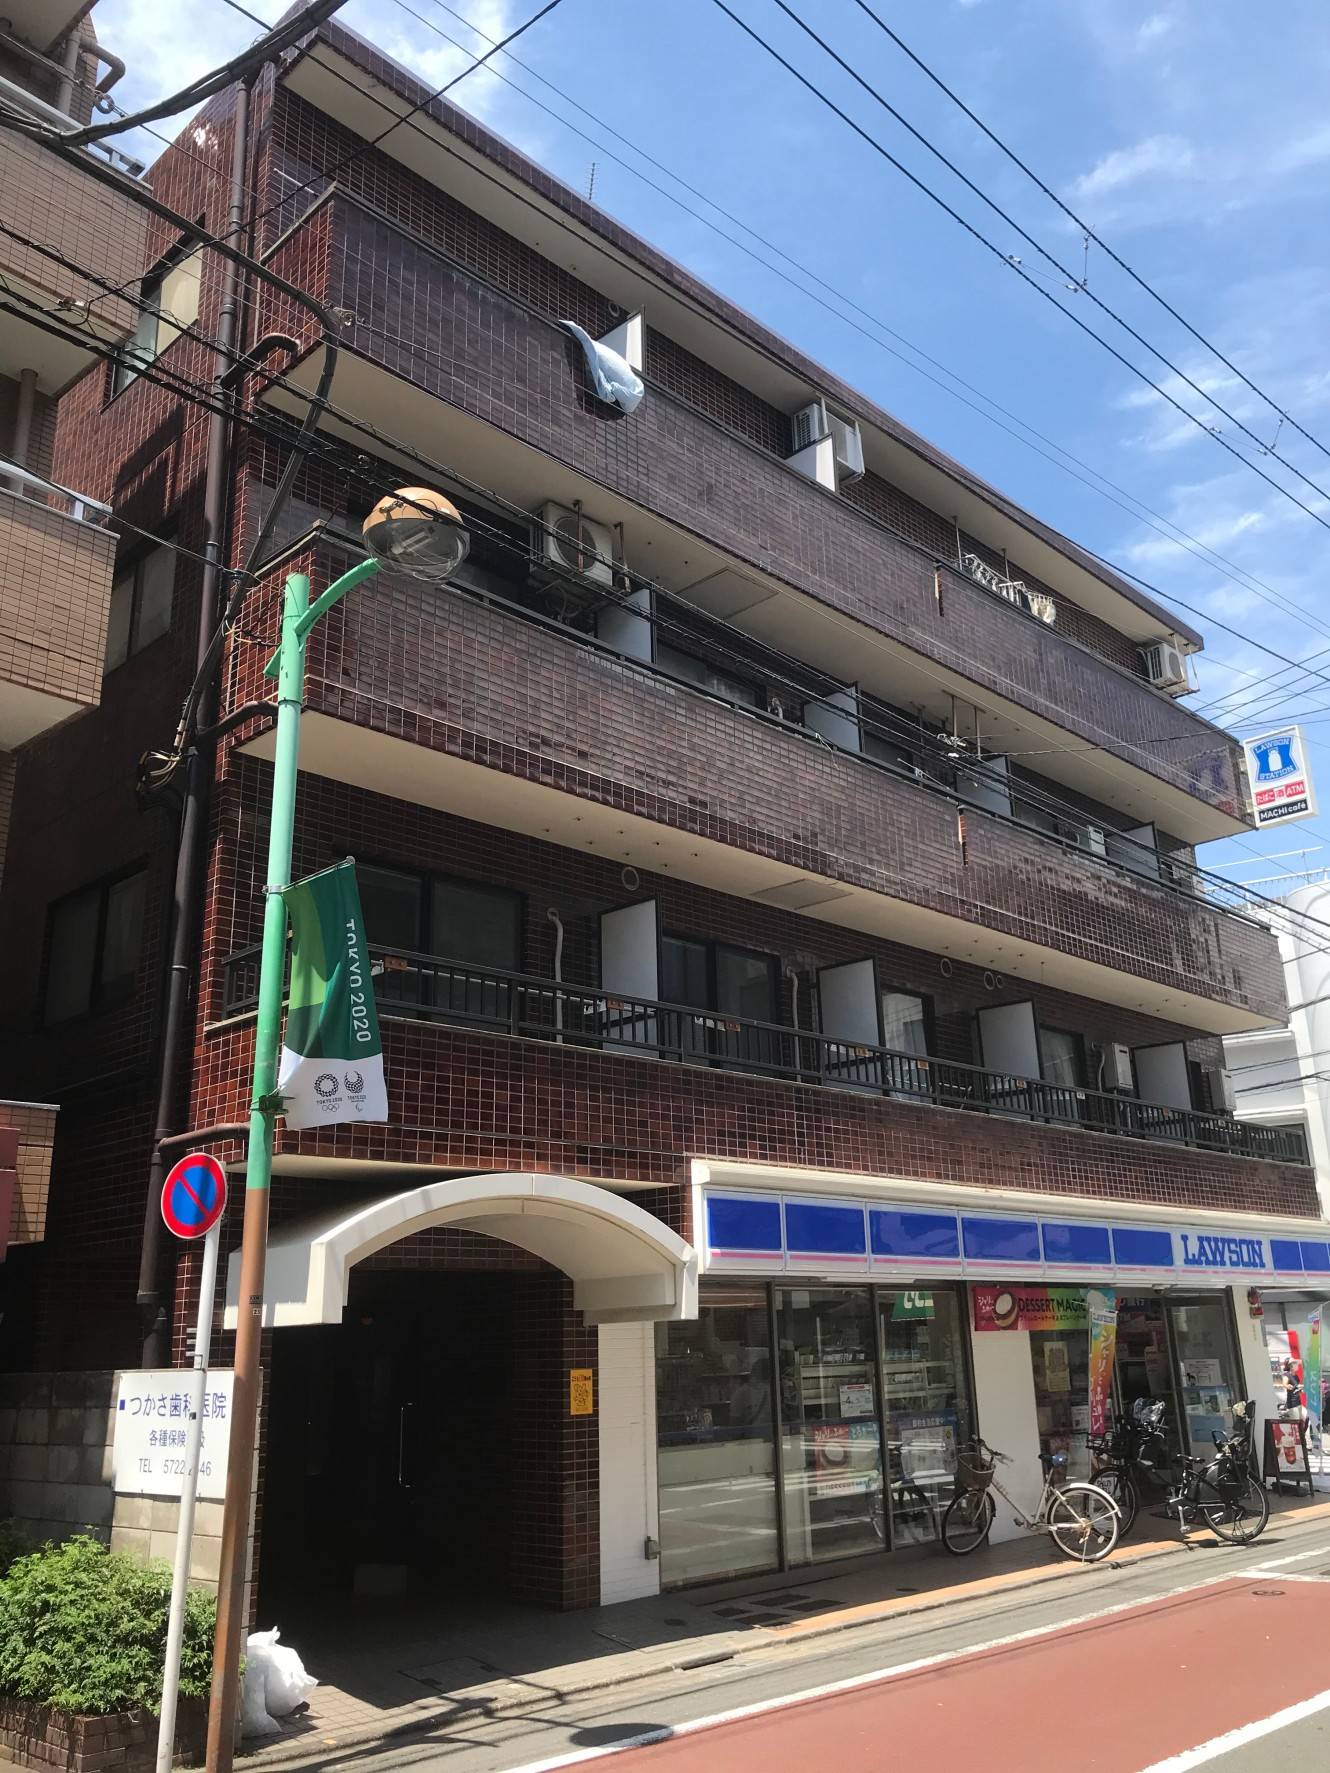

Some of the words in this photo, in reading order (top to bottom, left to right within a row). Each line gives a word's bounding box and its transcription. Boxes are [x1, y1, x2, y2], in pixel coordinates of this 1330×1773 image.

[1255, 738, 1290, 753] LAWSON
[1259, 765, 1294, 779] STATION
[1286, 783, 1304, 796] ATM
[1260, 806, 1288, 820] MACHI
[1288, 801, 1306, 812] café
[346, 918, 363, 988] TOKYO
[350, 993, 371, 1042] 2020
[1180, 1233, 1267, 1269] LAWSON
[1018, 1298, 1055, 1312] DESSERT
[149, 1429, 206, 1449] 各種保険
[138, 1458, 152, 1473] TEL
